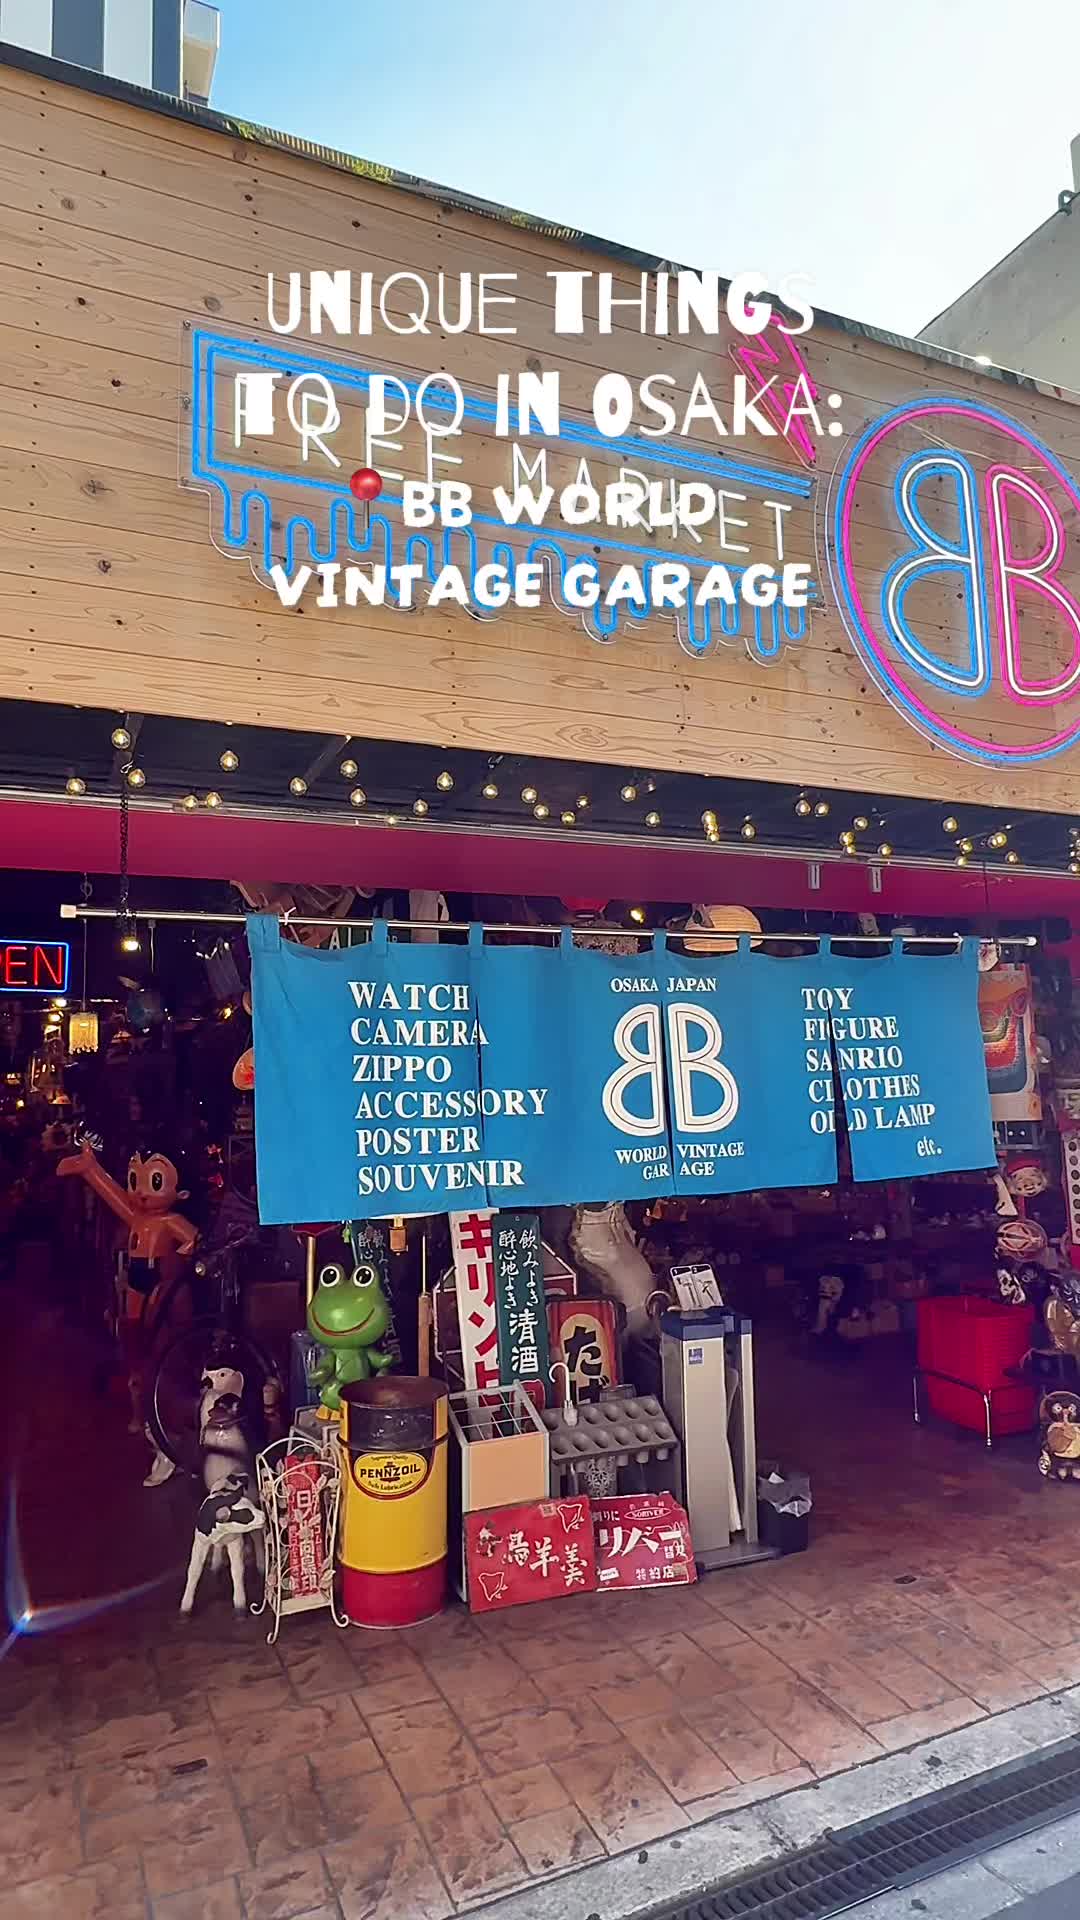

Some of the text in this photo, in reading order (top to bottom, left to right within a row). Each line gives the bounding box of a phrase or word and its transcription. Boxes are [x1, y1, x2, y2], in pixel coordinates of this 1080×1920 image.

[512, 441, 793, 561] MARKET
[0, 945, 63, 986] EN
[348, 981, 470, 1011] WATCH
[610, 977, 717, 992] OSAKA JAPAN
[801, 987, 854, 1011] TOY
[350, 1017, 489, 1046] CAMERA
[803, 1016, 899, 1041] FIGURE
[352, 1054, 452, 1083] ZIPPO
[806, 1045, 903, 1072] SANRIO
[808, 1074, 920, 1103] CLOTHES
[355, 1088, 548, 1120] ACCESSORY
[810, 1103, 936, 1134] OLD LAMP
[356, 1125, 480, 1157] POSTER
[615, 1141, 744, 1165] WORLD VINTAGE
[916, 1135, 943, 1158] etc.
[358, 1159, 525, 1196] SOUVENIR
[360, 1463, 421, 1479] PENNZOIL
